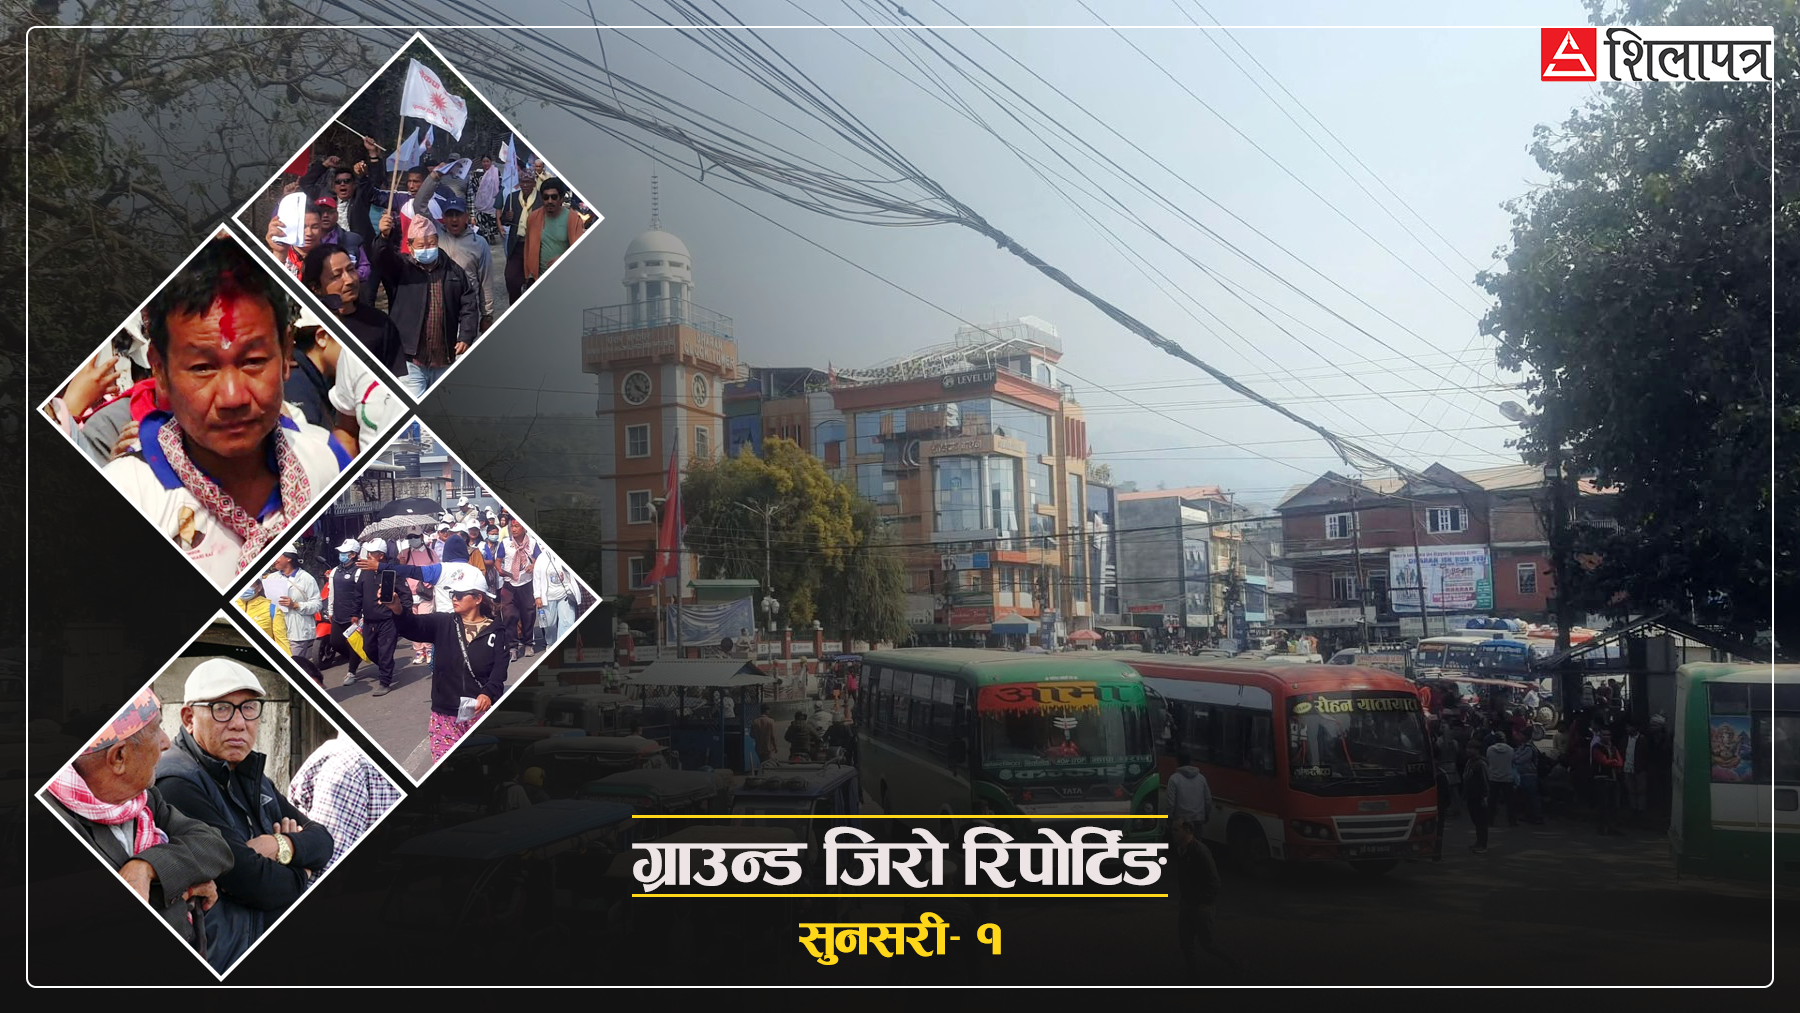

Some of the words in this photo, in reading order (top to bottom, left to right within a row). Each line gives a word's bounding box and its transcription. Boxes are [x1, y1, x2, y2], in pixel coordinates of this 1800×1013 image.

[696, 331, 723, 352] DHARAN
[684, 341, 709, 361] CLOCK
[710, 349, 735, 370] TOWER
[957, 374, 981, 385] LEVEL
[983, 372, 995, 382] UP
[487, 633, 496, 648] C
[1314, 696, 1354, 713] रोहन
[1357, 698, 1418, 712] यातायात
[1062, 787, 1083, 796] TATA
